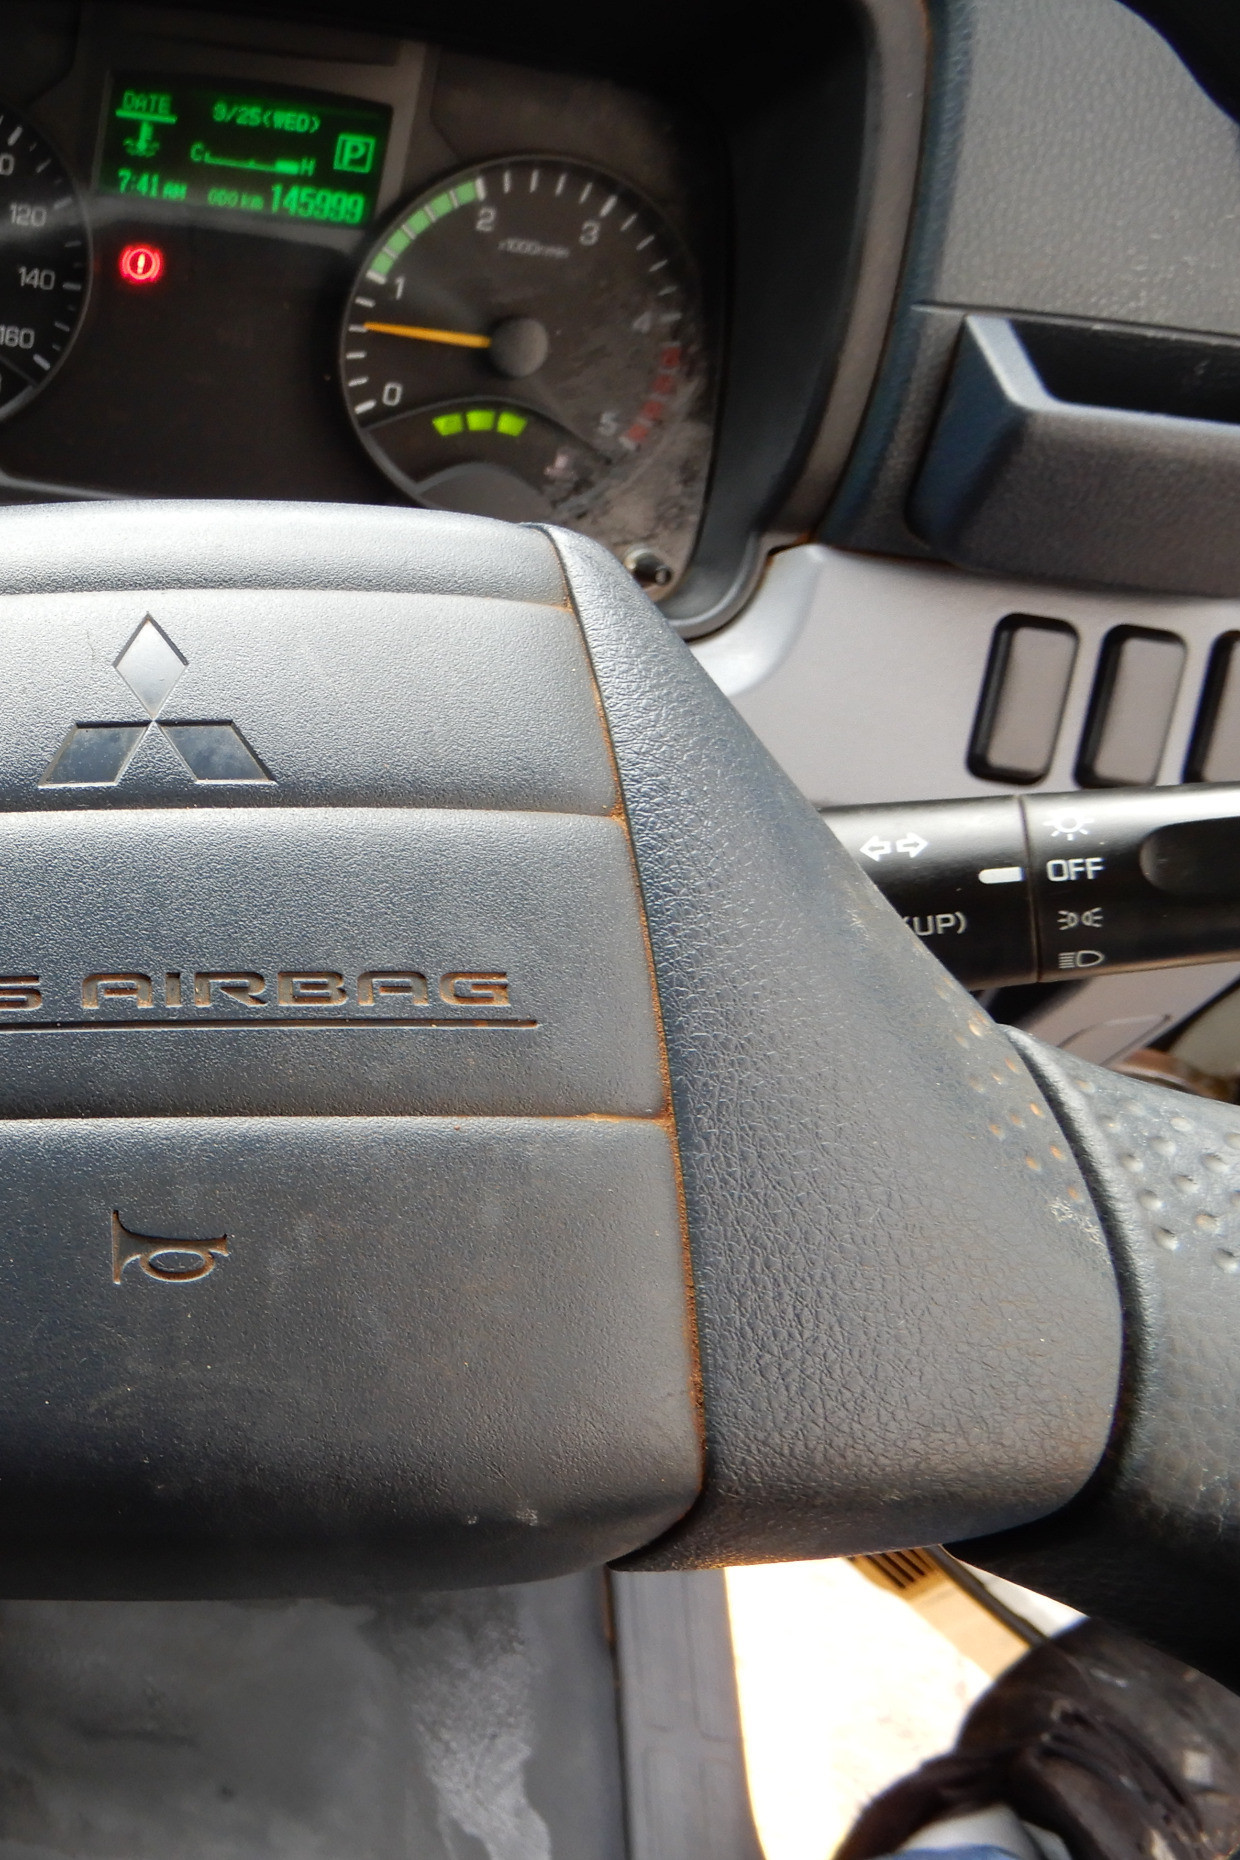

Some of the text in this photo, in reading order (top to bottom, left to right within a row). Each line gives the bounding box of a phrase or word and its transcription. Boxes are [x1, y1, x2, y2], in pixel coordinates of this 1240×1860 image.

[122, 89, 172, 115] DATE
[190, 142, 206, 163] C
[341, 138, 368, 168] P
[299, 157, 316, 177] H
[118, 168, 160, 198] 7:41
[10, 202, 47, 228] 120
[271, 182, 366, 225] 145999
[476, 207, 497, 232] 2
[579, 220, 601, 246] 3
[18, 266, 55, 290] 140
[394, 276, 406, 300] 1
[632, 310, 652, 334] 4
[382, 382, 403, 407] 0
[599, 410, 619, 436] 5
[1046, 857, 1106, 882] OFF
[79, 970, 511, 1010] AIRBAG
